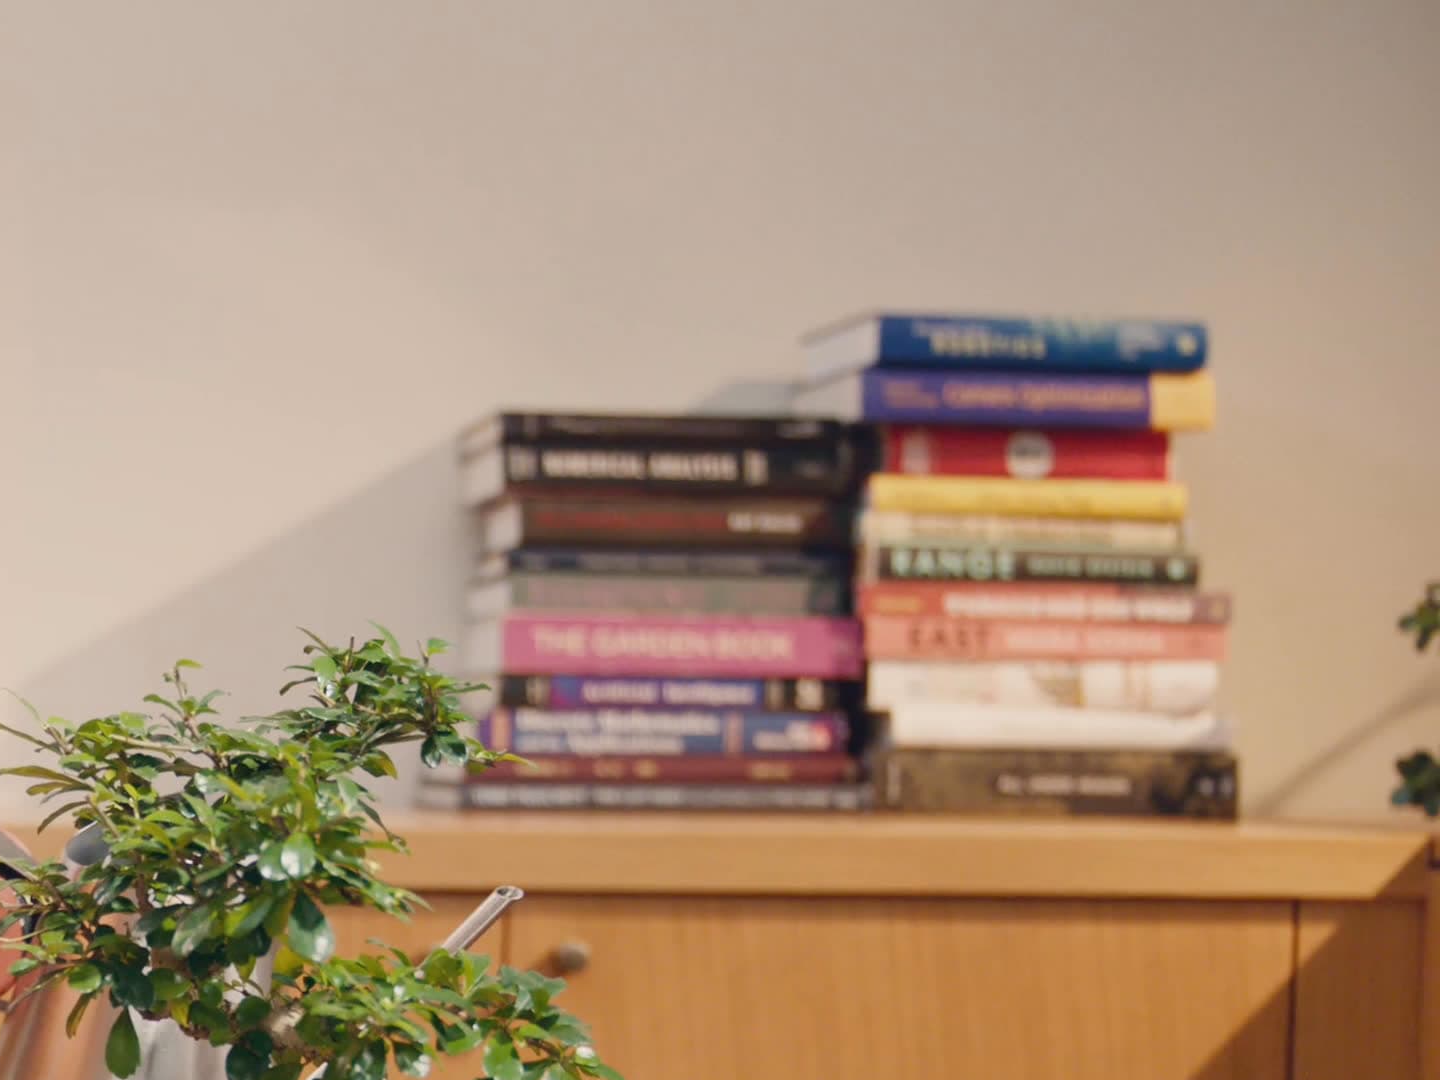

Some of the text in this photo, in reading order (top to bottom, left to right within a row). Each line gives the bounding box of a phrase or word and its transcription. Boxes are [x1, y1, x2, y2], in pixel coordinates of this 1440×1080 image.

[891, 549, 1015, 579] RANGE
[532, 625, 586, 656] THE
[591, 627, 709, 658] GARDEN
